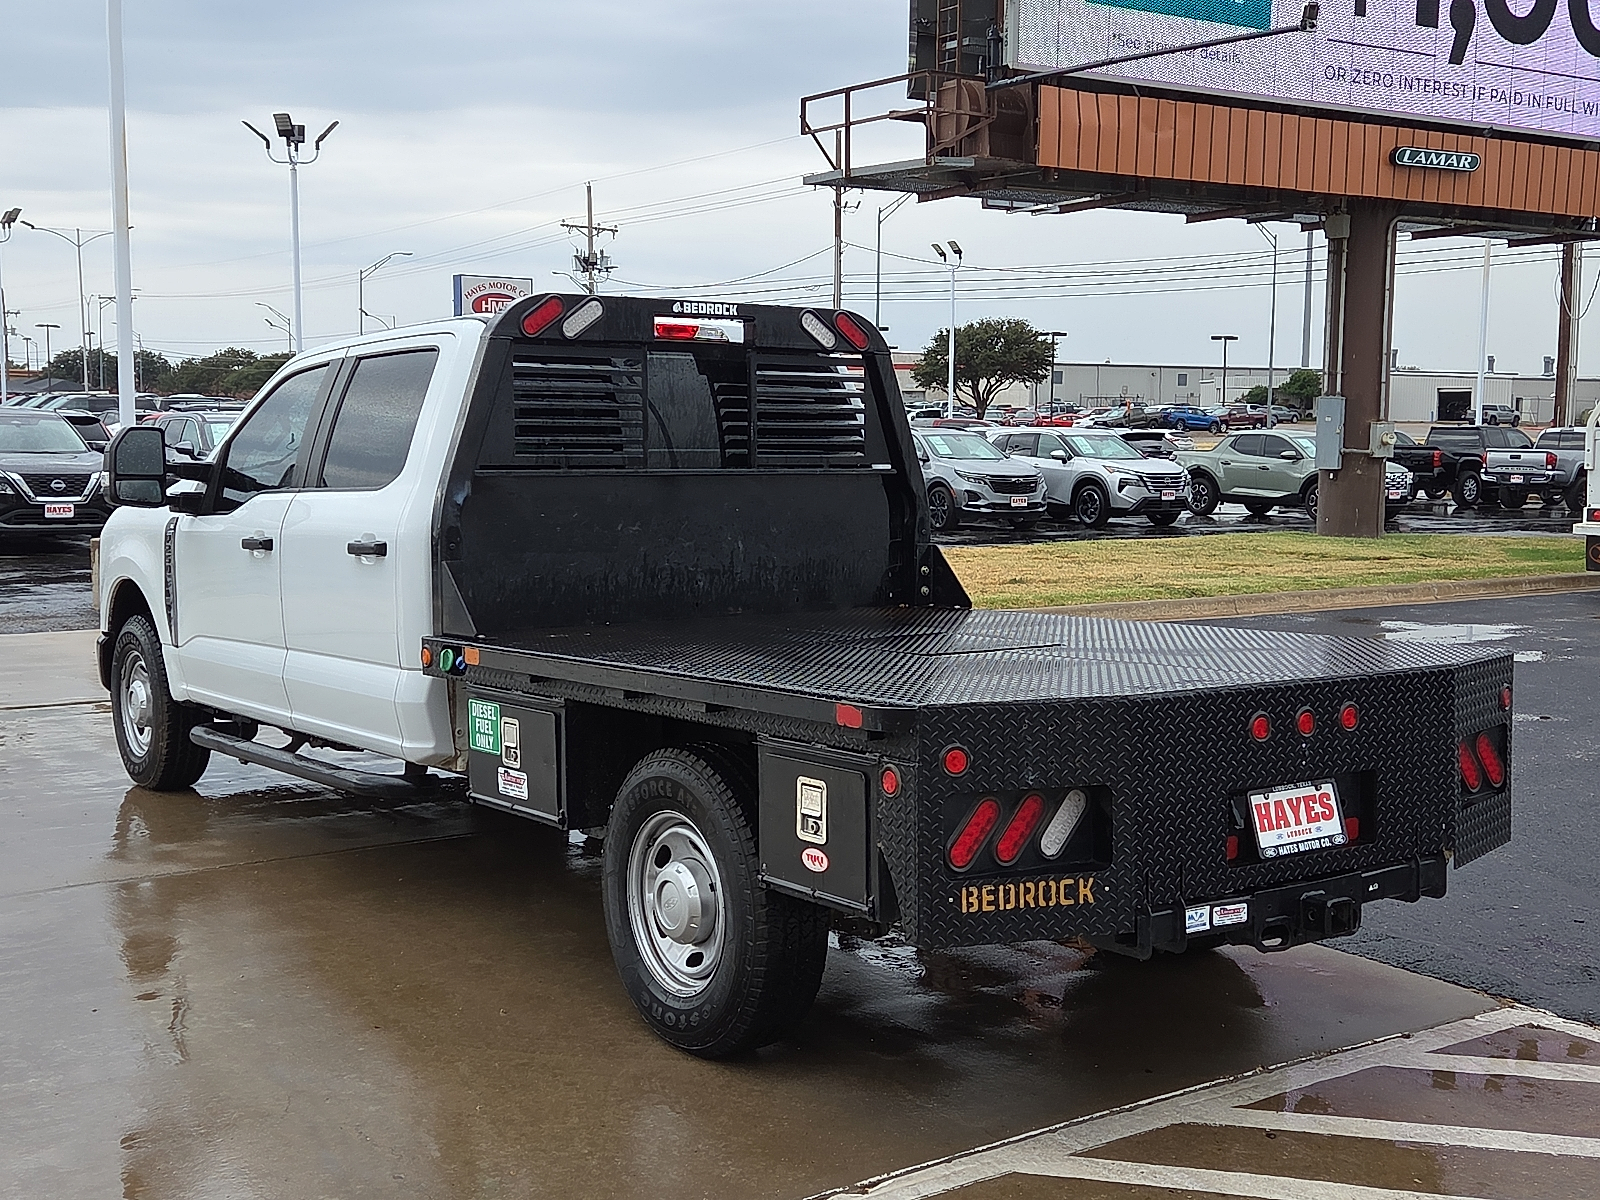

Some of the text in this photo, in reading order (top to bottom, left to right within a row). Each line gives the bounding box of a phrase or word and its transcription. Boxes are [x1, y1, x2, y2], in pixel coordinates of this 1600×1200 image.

[1324, 65, 1346, 81] OR
[1350, 69, 1394, 88] ZERO
[1398, 75, 1468, 98] INTEREST
[1473, 85, 1486, 100] IF
[1490, 88, 1523, 105] PAID
[1528, 93, 1541, 109] IN
[1546, 96, 1578, 114] FULL
[1402, 149, 1472, 169] LAMAR
[464, 283, 487, 300] HAYES
[488, 281, 518, 294] MOTOR
[683, 301, 739, 316] BEDROCK
[471, 702, 497, 721] DIESEL
[475, 717, 494, 735] FUEL
[476, 732, 494, 750] ONLY
[1254, 792, 1335, 833] HAYES
[1278, 843, 1299, 856] HAYES
[1299, 839, 1321, 852] MOTOR
[1321, 837, 1332, 848] CO.
[961, 877, 1094, 914] BEDROCK
